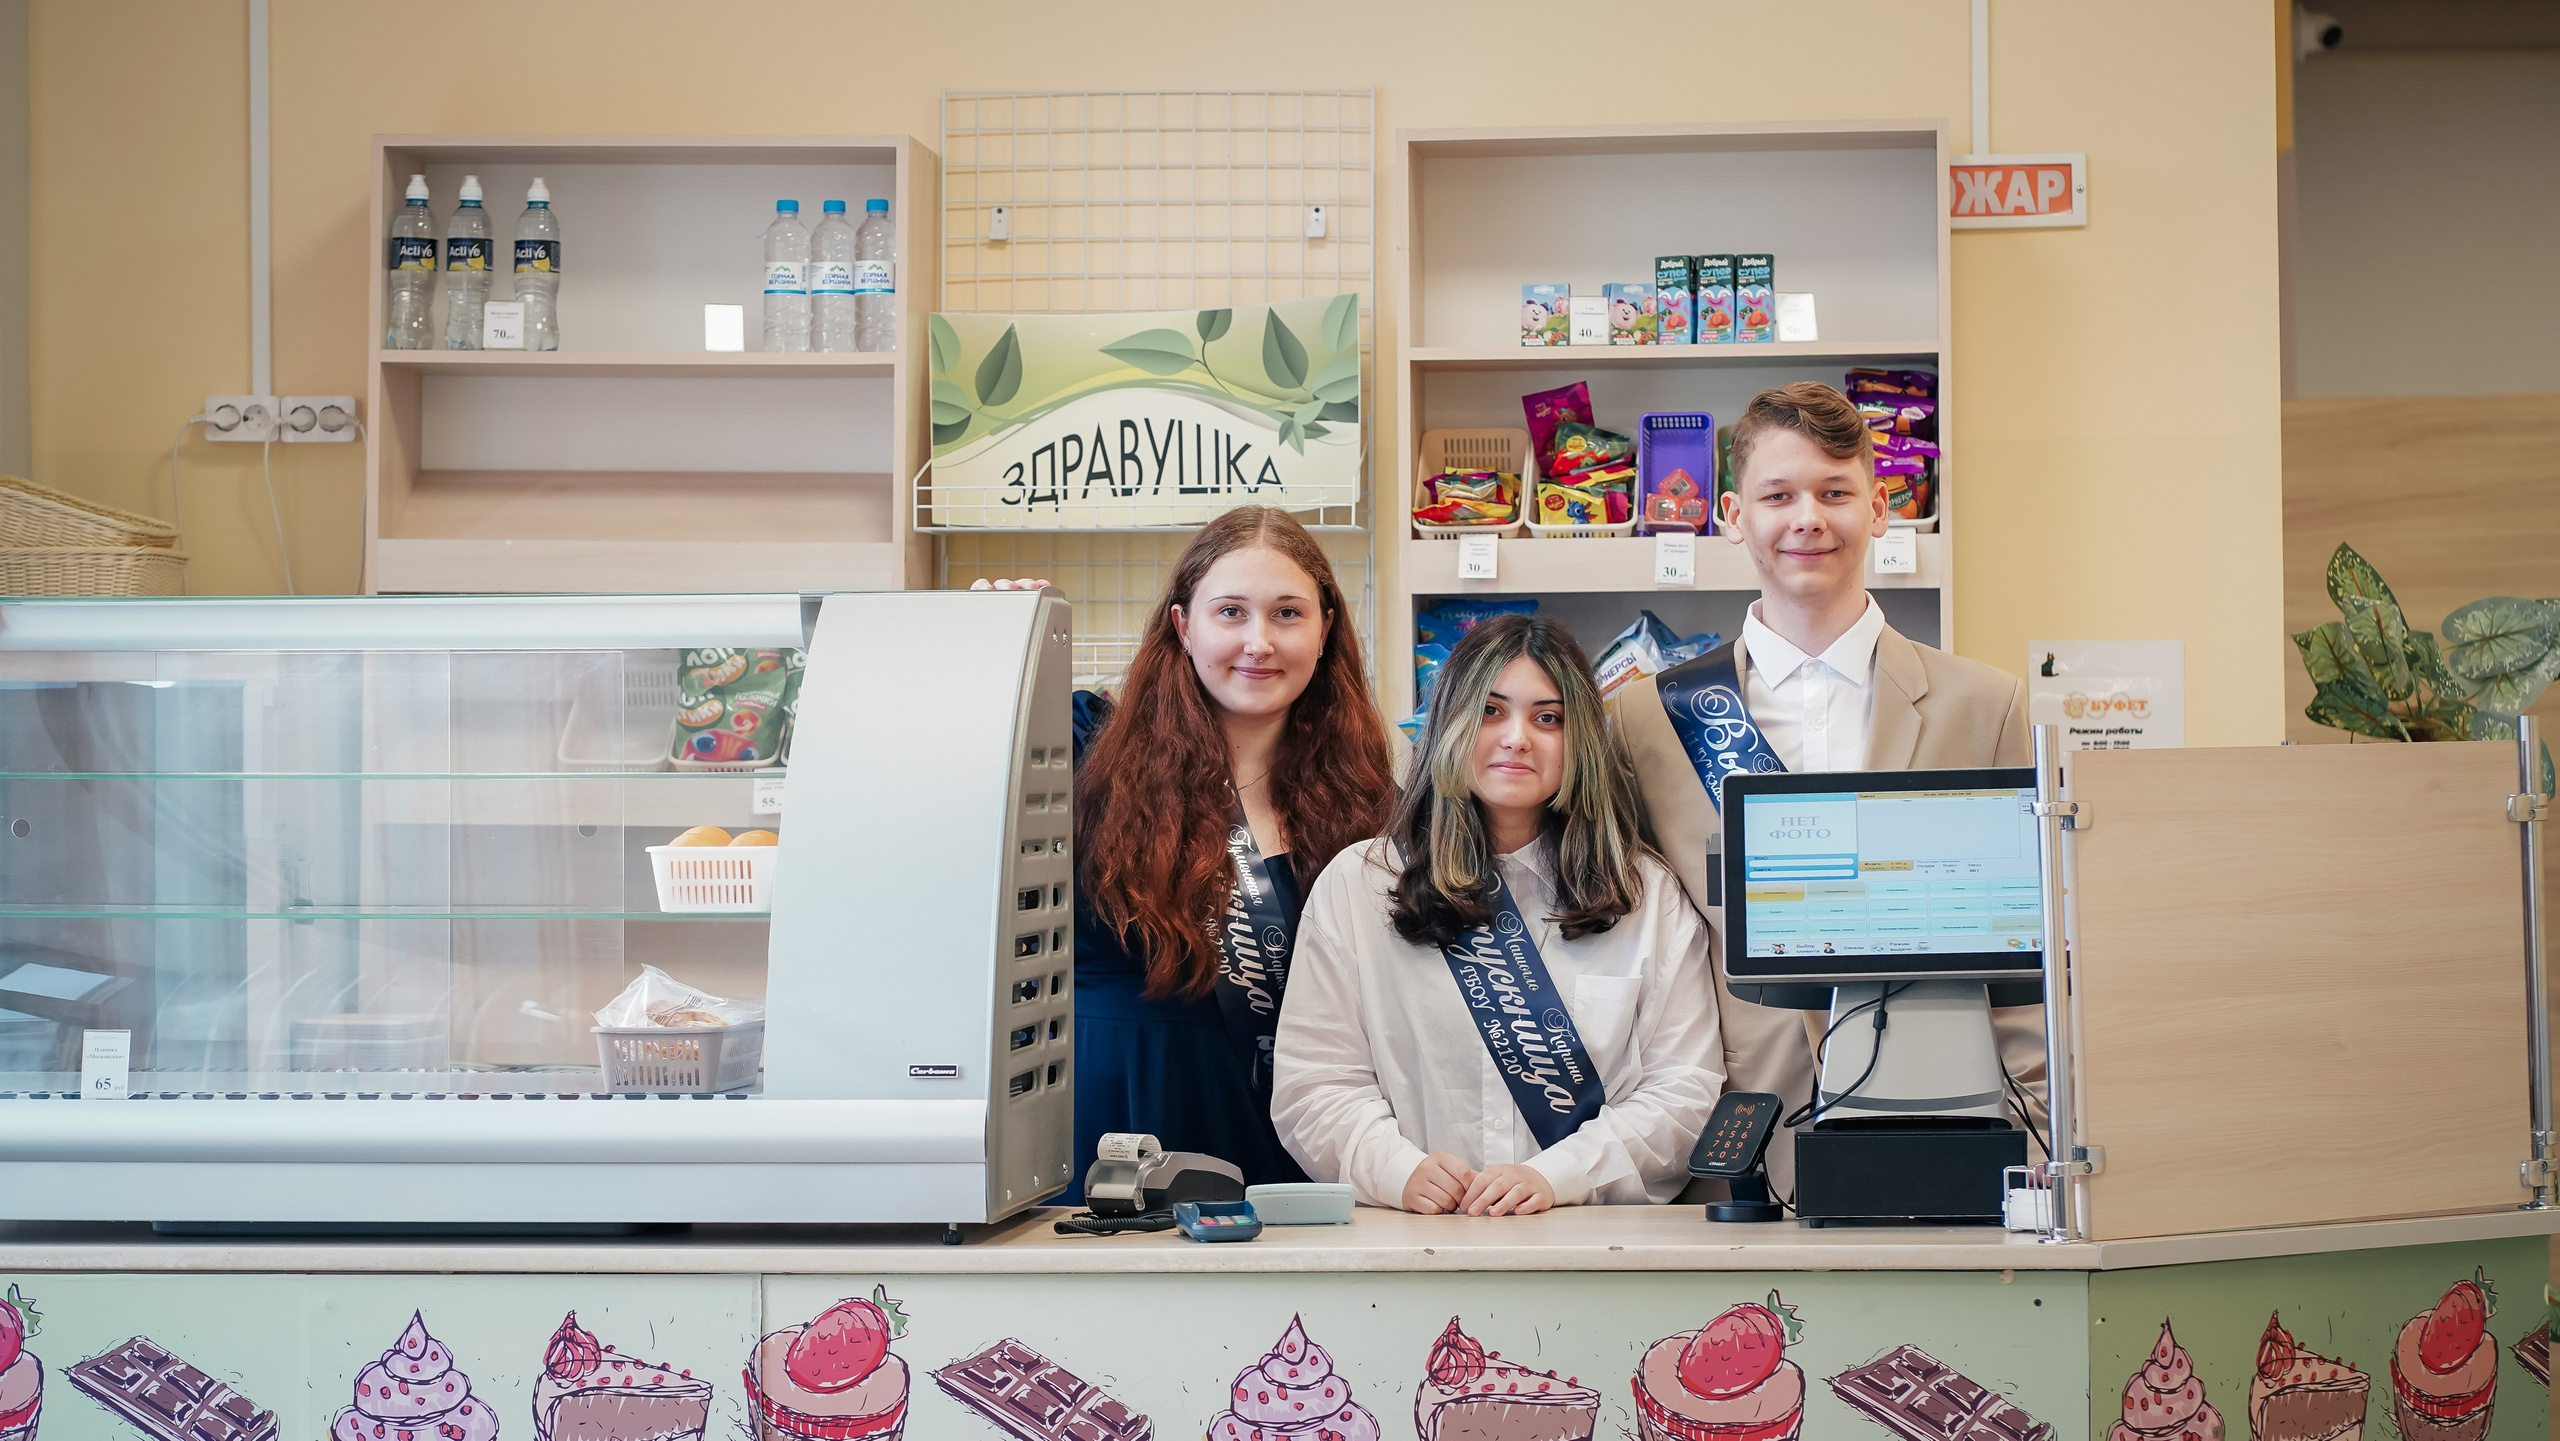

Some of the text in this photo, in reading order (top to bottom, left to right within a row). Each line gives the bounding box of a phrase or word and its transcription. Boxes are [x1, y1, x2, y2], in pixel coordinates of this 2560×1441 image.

[1950, 169, 2066, 215] ЖАР
[400, 243, 433, 258] Active
[449, 242, 481, 257] Active
[515, 244, 546, 259] Active
[493, 329, 507, 339] 70
[1578, 328, 1592, 338] 40
[1001, 416, 1288, 513] ЗДРАВУШКА
[1883, 556, 1897, 566] 65
[1466, 563, 1480, 573] 30
[1663, 566, 1677, 577] 30
[2090, 700, 2148, 711] БУФЕТ
[2069, 726, 2143, 736] Режим работы
[761, 798, 775, 808] 55
[1780, 816, 1820, 827] НЕТ
[1769, 828, 1831, 839] ФОТО
[1447, 922, 1577, 1115] пускница
[1459, 965, 1524, 1075] ГБОУ №2120
[1541, 1007, 1586, 1085] Карина
[910, 1067, 956, 1075] Carboma
[95, 1077, 112, 1091] 65
[1723, 1119, 1753, 1129] 1 2 3
[1729, 1130, 1736, 1138] 5
[1740, 1131, 1748, 1139] 6
[1724, 1140, 1731, 1148] 8
[1736, 1141, 1744, 1149] 9
[1719, 1150, 1726, 1159] 0
